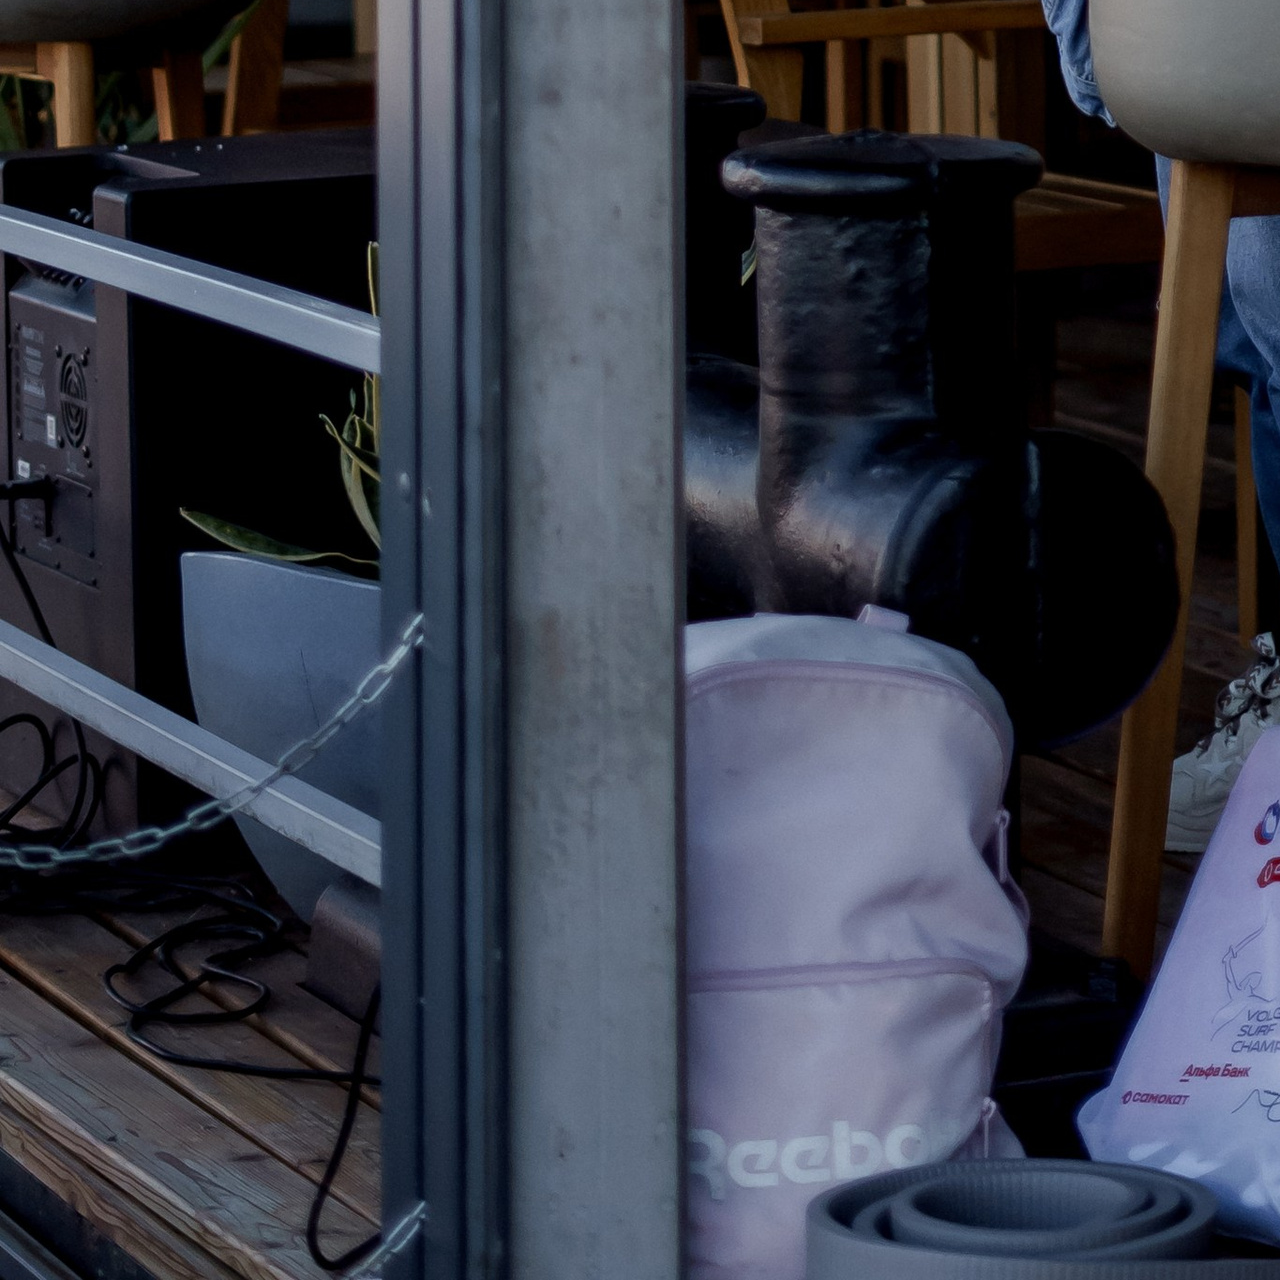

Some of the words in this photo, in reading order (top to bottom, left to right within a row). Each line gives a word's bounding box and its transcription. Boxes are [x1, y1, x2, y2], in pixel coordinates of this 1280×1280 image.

[1237, 1023, 1277, 1037] SURF
[1182, 1064, 1220, 1080] Альфа
[1221, 1064, 1251, 1078] Банк
